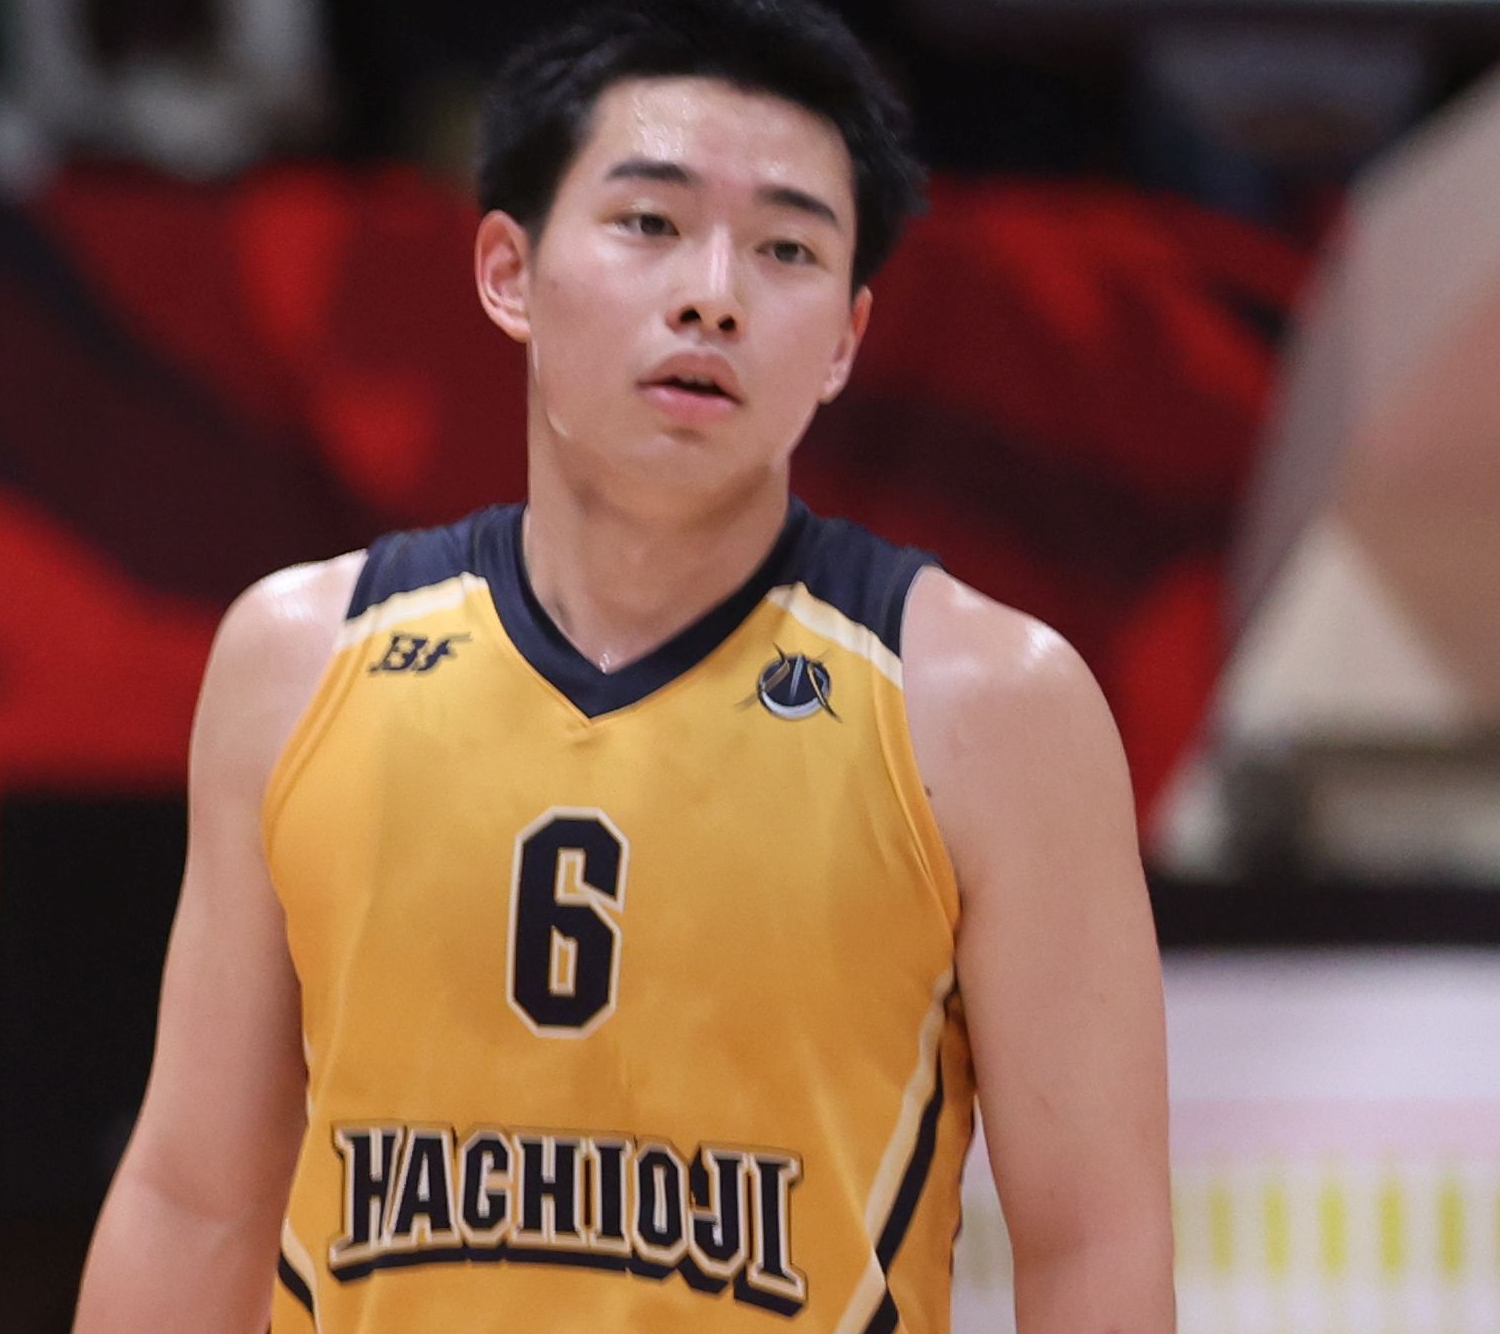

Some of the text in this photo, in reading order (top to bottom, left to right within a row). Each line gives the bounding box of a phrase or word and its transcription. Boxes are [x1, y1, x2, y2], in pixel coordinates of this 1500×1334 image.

[367, 632, 472, 673] BF
[504, 805, 630, 1039] 6
[328, 1120, 807, 1317] HACHIOJI
